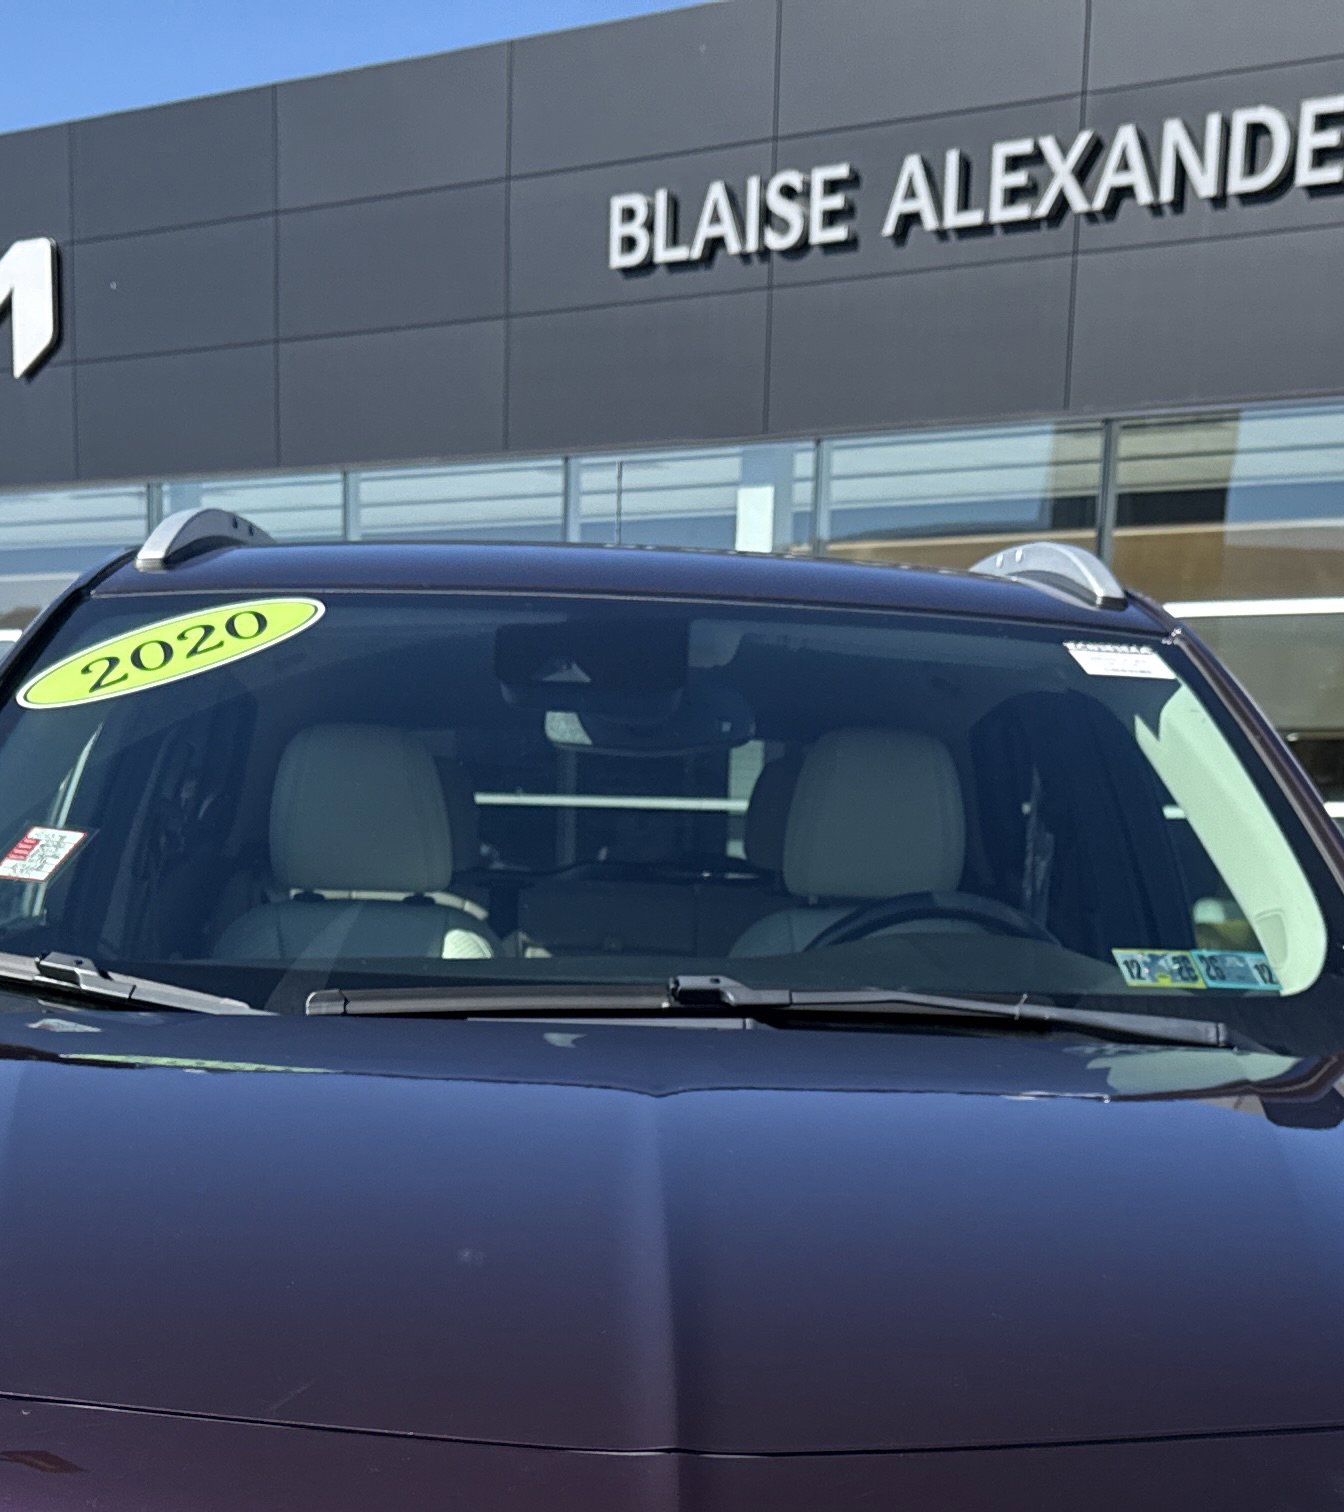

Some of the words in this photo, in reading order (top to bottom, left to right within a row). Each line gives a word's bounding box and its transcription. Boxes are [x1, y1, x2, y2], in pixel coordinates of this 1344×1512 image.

[609, 162, 851, 269] BLAISE
[80, 610, 269, 694] 2020
[1123, 959, 1147, 980] 12
[1198, 955, 1226, 981] 26
[1254, 962, 1281, 985] 12
